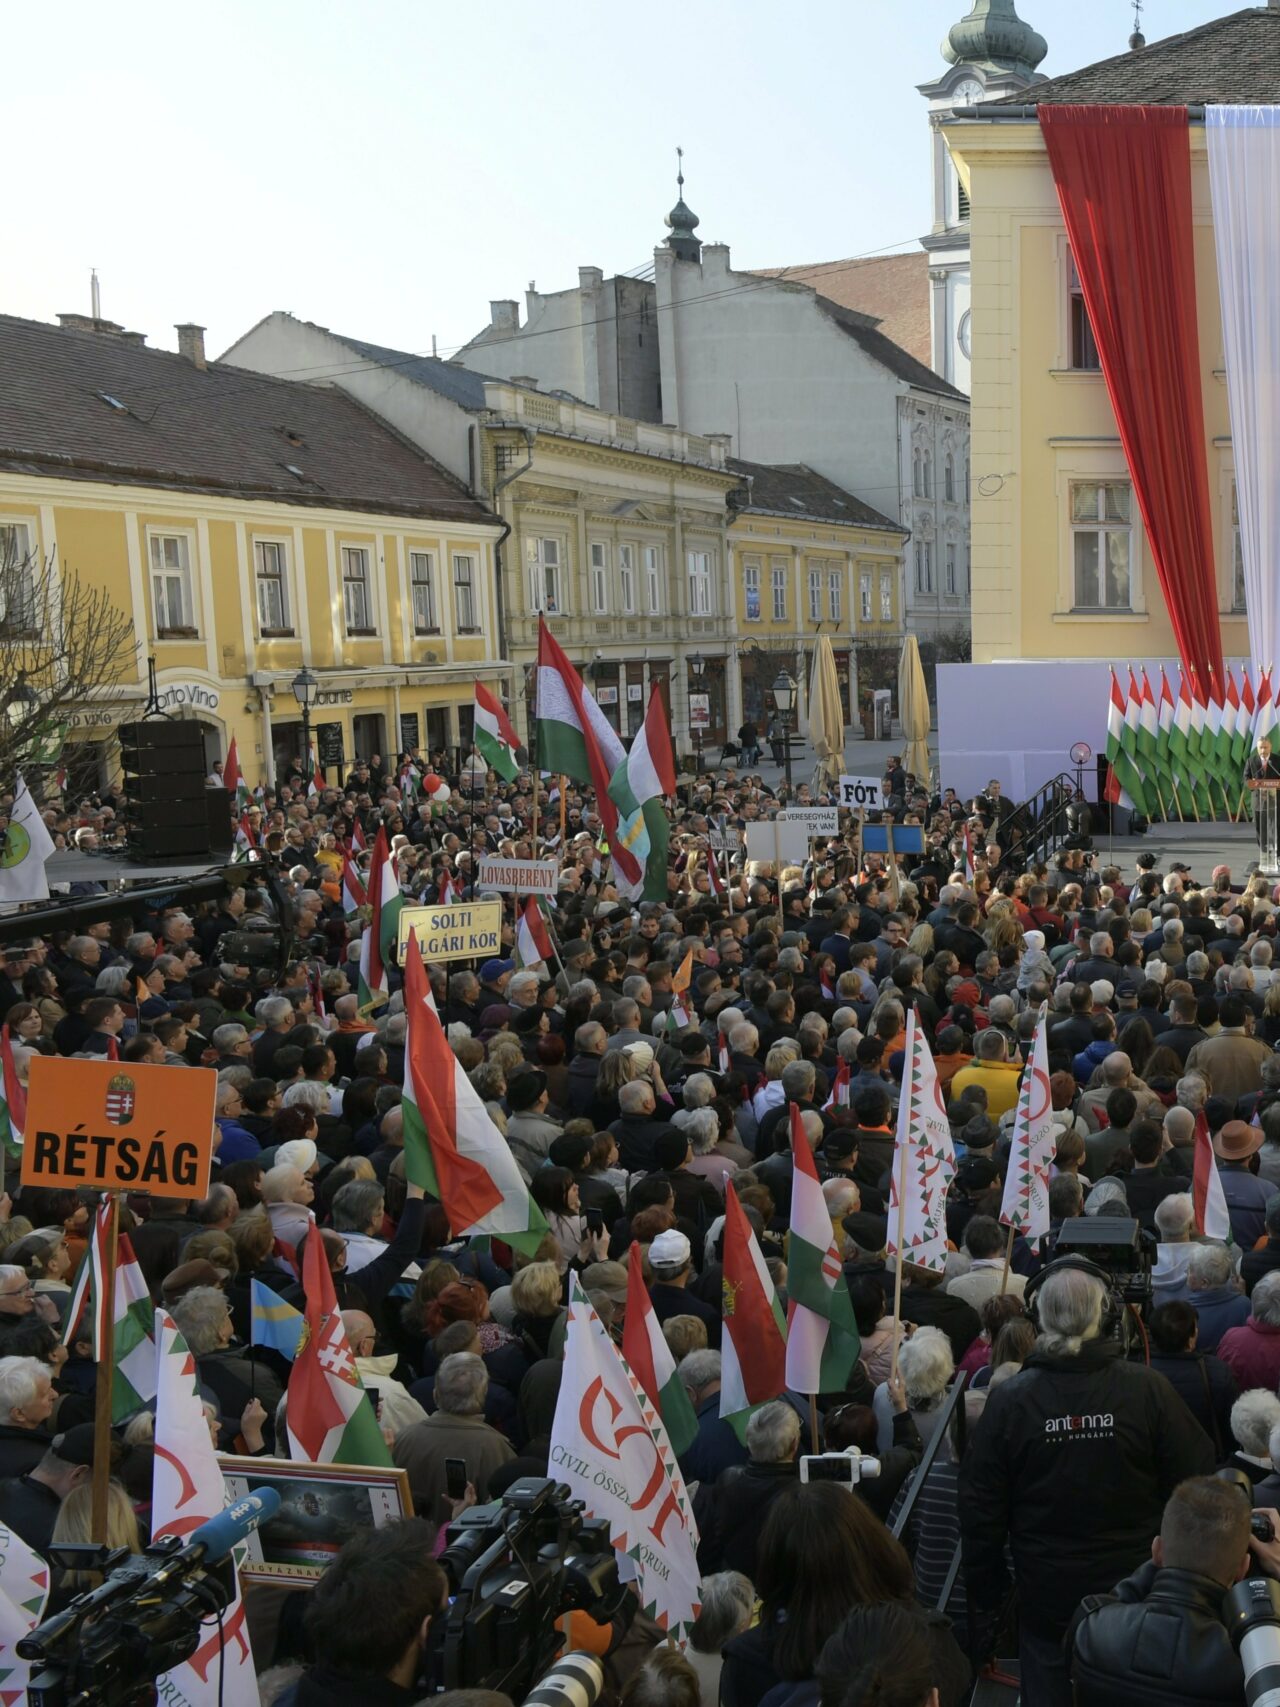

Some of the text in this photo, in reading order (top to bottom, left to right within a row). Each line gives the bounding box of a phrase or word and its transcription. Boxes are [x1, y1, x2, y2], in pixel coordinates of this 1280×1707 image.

[151, 685, 218, 709] orto Vino
[308, 688, 353, 706] torante
[843, 780, 878, 804] FÓT
[787, 812, 836, 821] VERESEGYHÁZ
[481, 864, 555, 888] LOVASBERÉNY
[431, 911, 472, 930] SOLTI
[400, 929, 497, 957] PLGÁRI KÖR
[33, 1124, 199, 1186] RÉTSÁG
[1045, 1413, 1114, 1433] antenna
[1068, 1431, 1114, 1440] HUNGÁRIA
[551, 1444, 590, 1480] CIVIL
[230, 1503, 250, 1521] AFP
[247, 1516, 260, 1532] TV
[640, 1543, 670, 1582] ÓRUM
